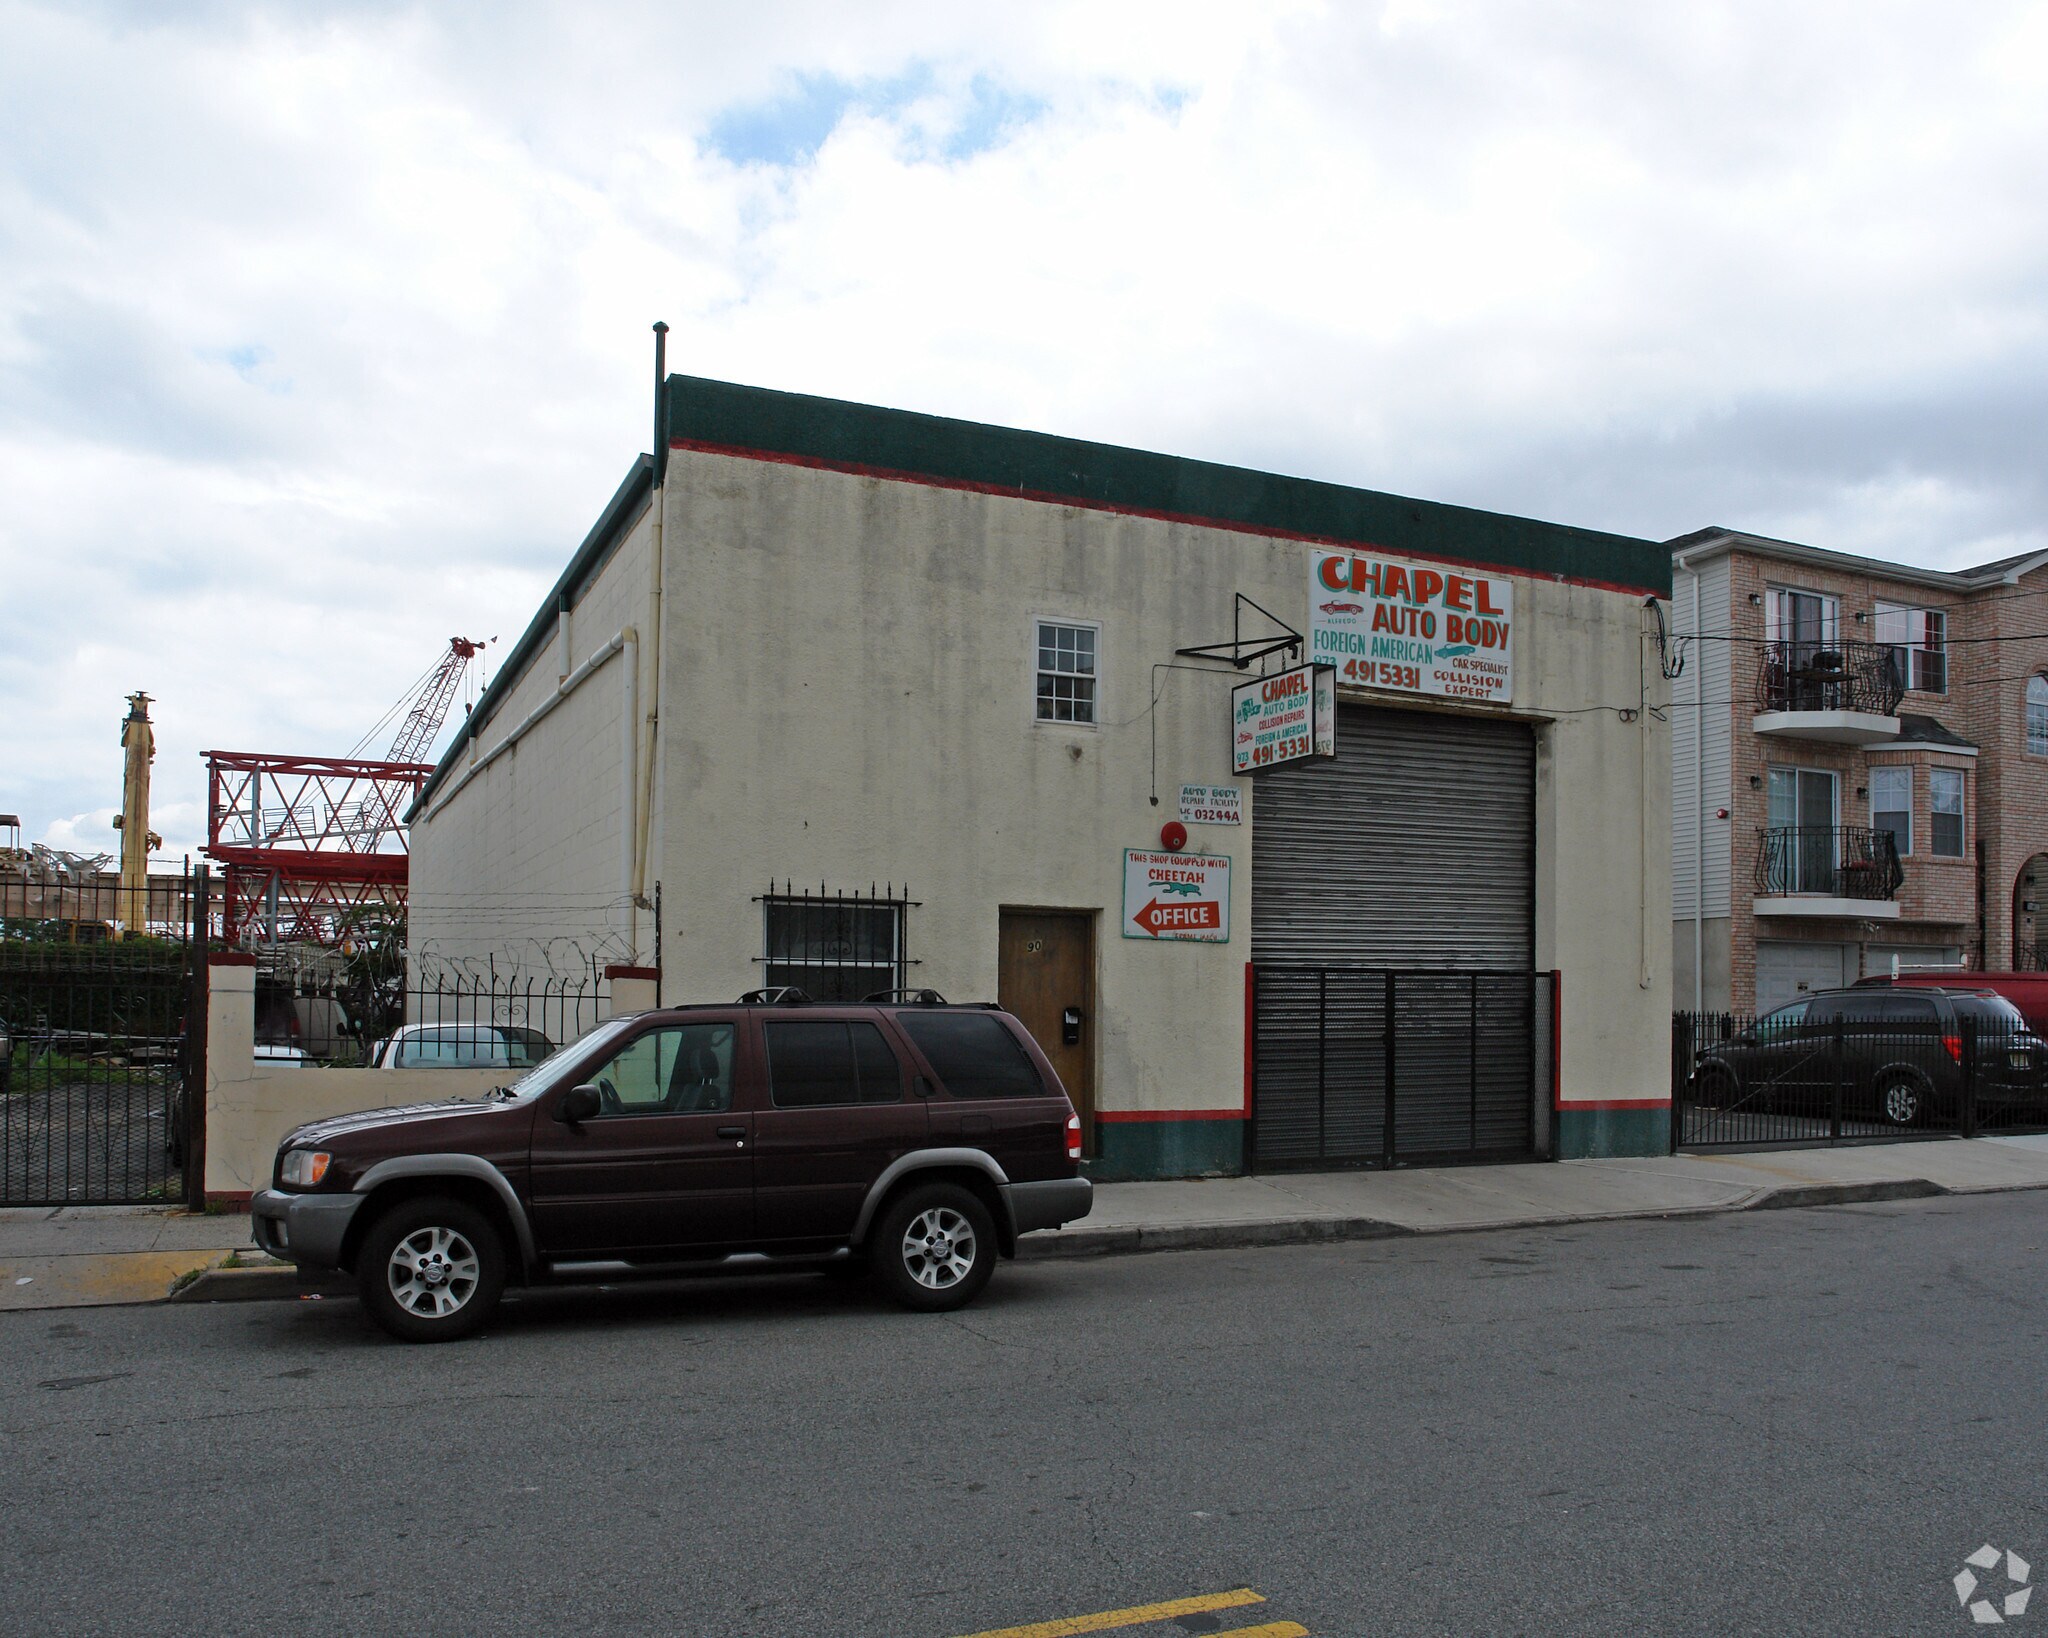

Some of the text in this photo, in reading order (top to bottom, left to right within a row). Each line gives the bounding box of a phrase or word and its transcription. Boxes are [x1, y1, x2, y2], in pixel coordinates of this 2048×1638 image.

[1317, 556, 1504, 618] CHAPEL
[1371, 603, 1510, 651] AUTO BODY
[1313, 629, 1433, 665] FOREIGN AMERICAN
[1313, 655, 1420, 690] 973 491 5331
[1452, 657, 1508, 676] CAR SPECIALIST
[1261, 672, 1309, 704] CHAPEL
[1433, 670, 1503, 689] COLLISION
[1445, 685, 1491, 699] EXPERT
[1263, 694, 1309, 717] AUTO BODY
[1258, 709, 1305, 731] COLLISION REPAIRS
[1255, 731, 1276, 746] FOREIGN
[1281, 723, 1308, 739] AMERICAN
[1236, 751, 1249, 763] 973
[1181, 796, 1240, 808] REPAIR FACILITY
[1182, 787, 1238, 798] AUTO BODY
[1194, 809, 1240, 822] 03244A
[1129, 853, 1228, 869] THIS SHOP EQUIPPED WITH
[1148, 868, 1205, 884] CHEETAH
[1150, 906, 1210, 926] OFFICE
[1027, 940, 1042, 953] 90
